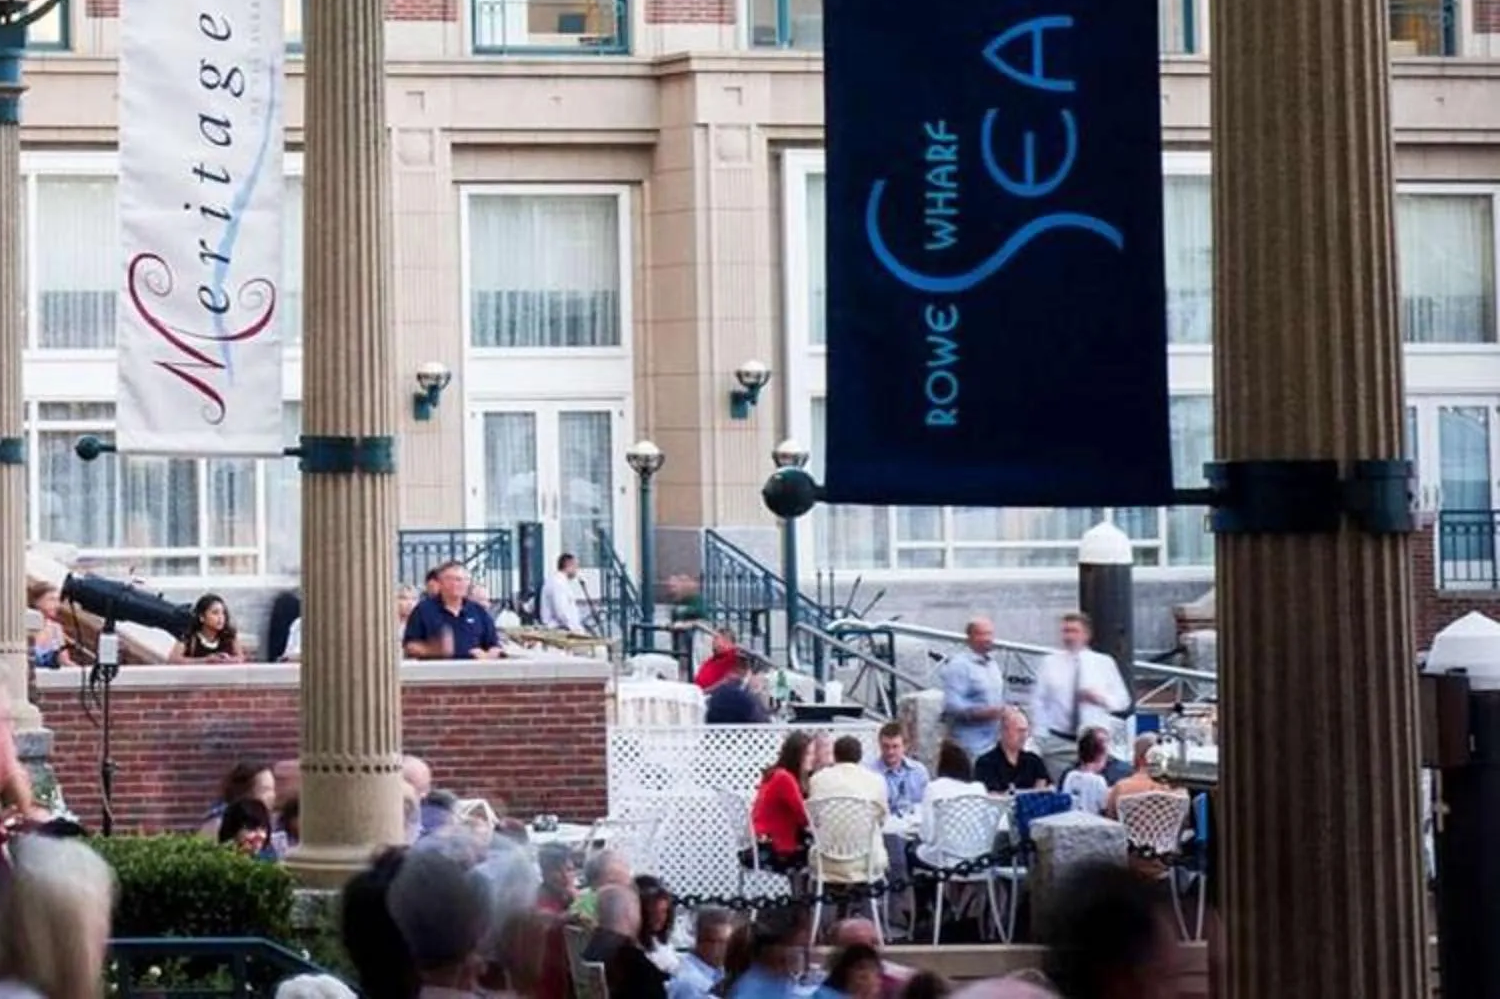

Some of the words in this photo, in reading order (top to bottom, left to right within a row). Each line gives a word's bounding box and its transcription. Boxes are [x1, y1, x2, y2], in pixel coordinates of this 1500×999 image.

[128, 11, 277, 426] Meritage
[864, 13, 1124, 292] SEA
[925, 120, 959, 250] WHARF
[925, 301, 960, 426] ROWE
